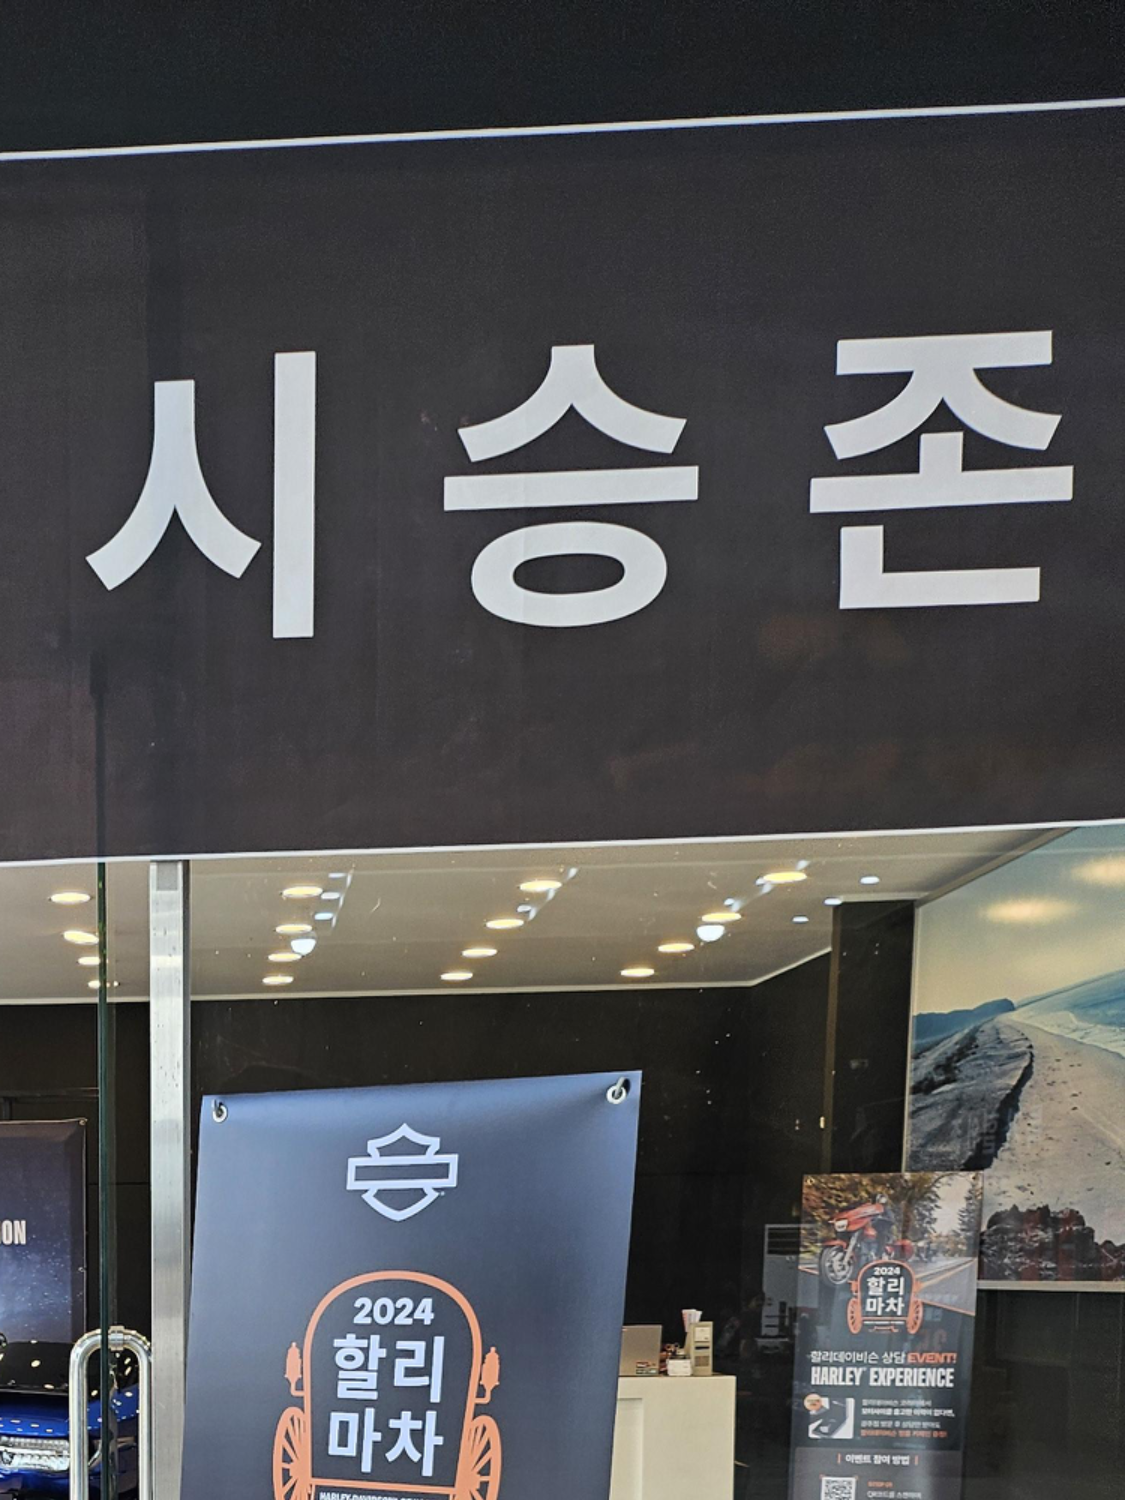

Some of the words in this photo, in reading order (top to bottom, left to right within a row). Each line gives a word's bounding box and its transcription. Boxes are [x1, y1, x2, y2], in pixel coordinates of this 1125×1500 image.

[84, 329, 1074, 638] 시승존
[874, 1266, 901, 1276] 2024
[866, 1276, 905, 1296] 할리
[353, 1297, 434, 1325] 2024
[865, 1297, 905, 1316] 마차
[333, 1333, 445, 1403] 할리
[811, 1351, 879, 1364] 할리데이비슨
[882, 1352, 905, 1364] 상담
[907, 1352, 957, 1365] EVENT!
[811, 1366, 864, 1386] HARLEY
[869, 1367, 955, 1387] EXPERIENCE
[328, 1407, 444, 1477] 마차
